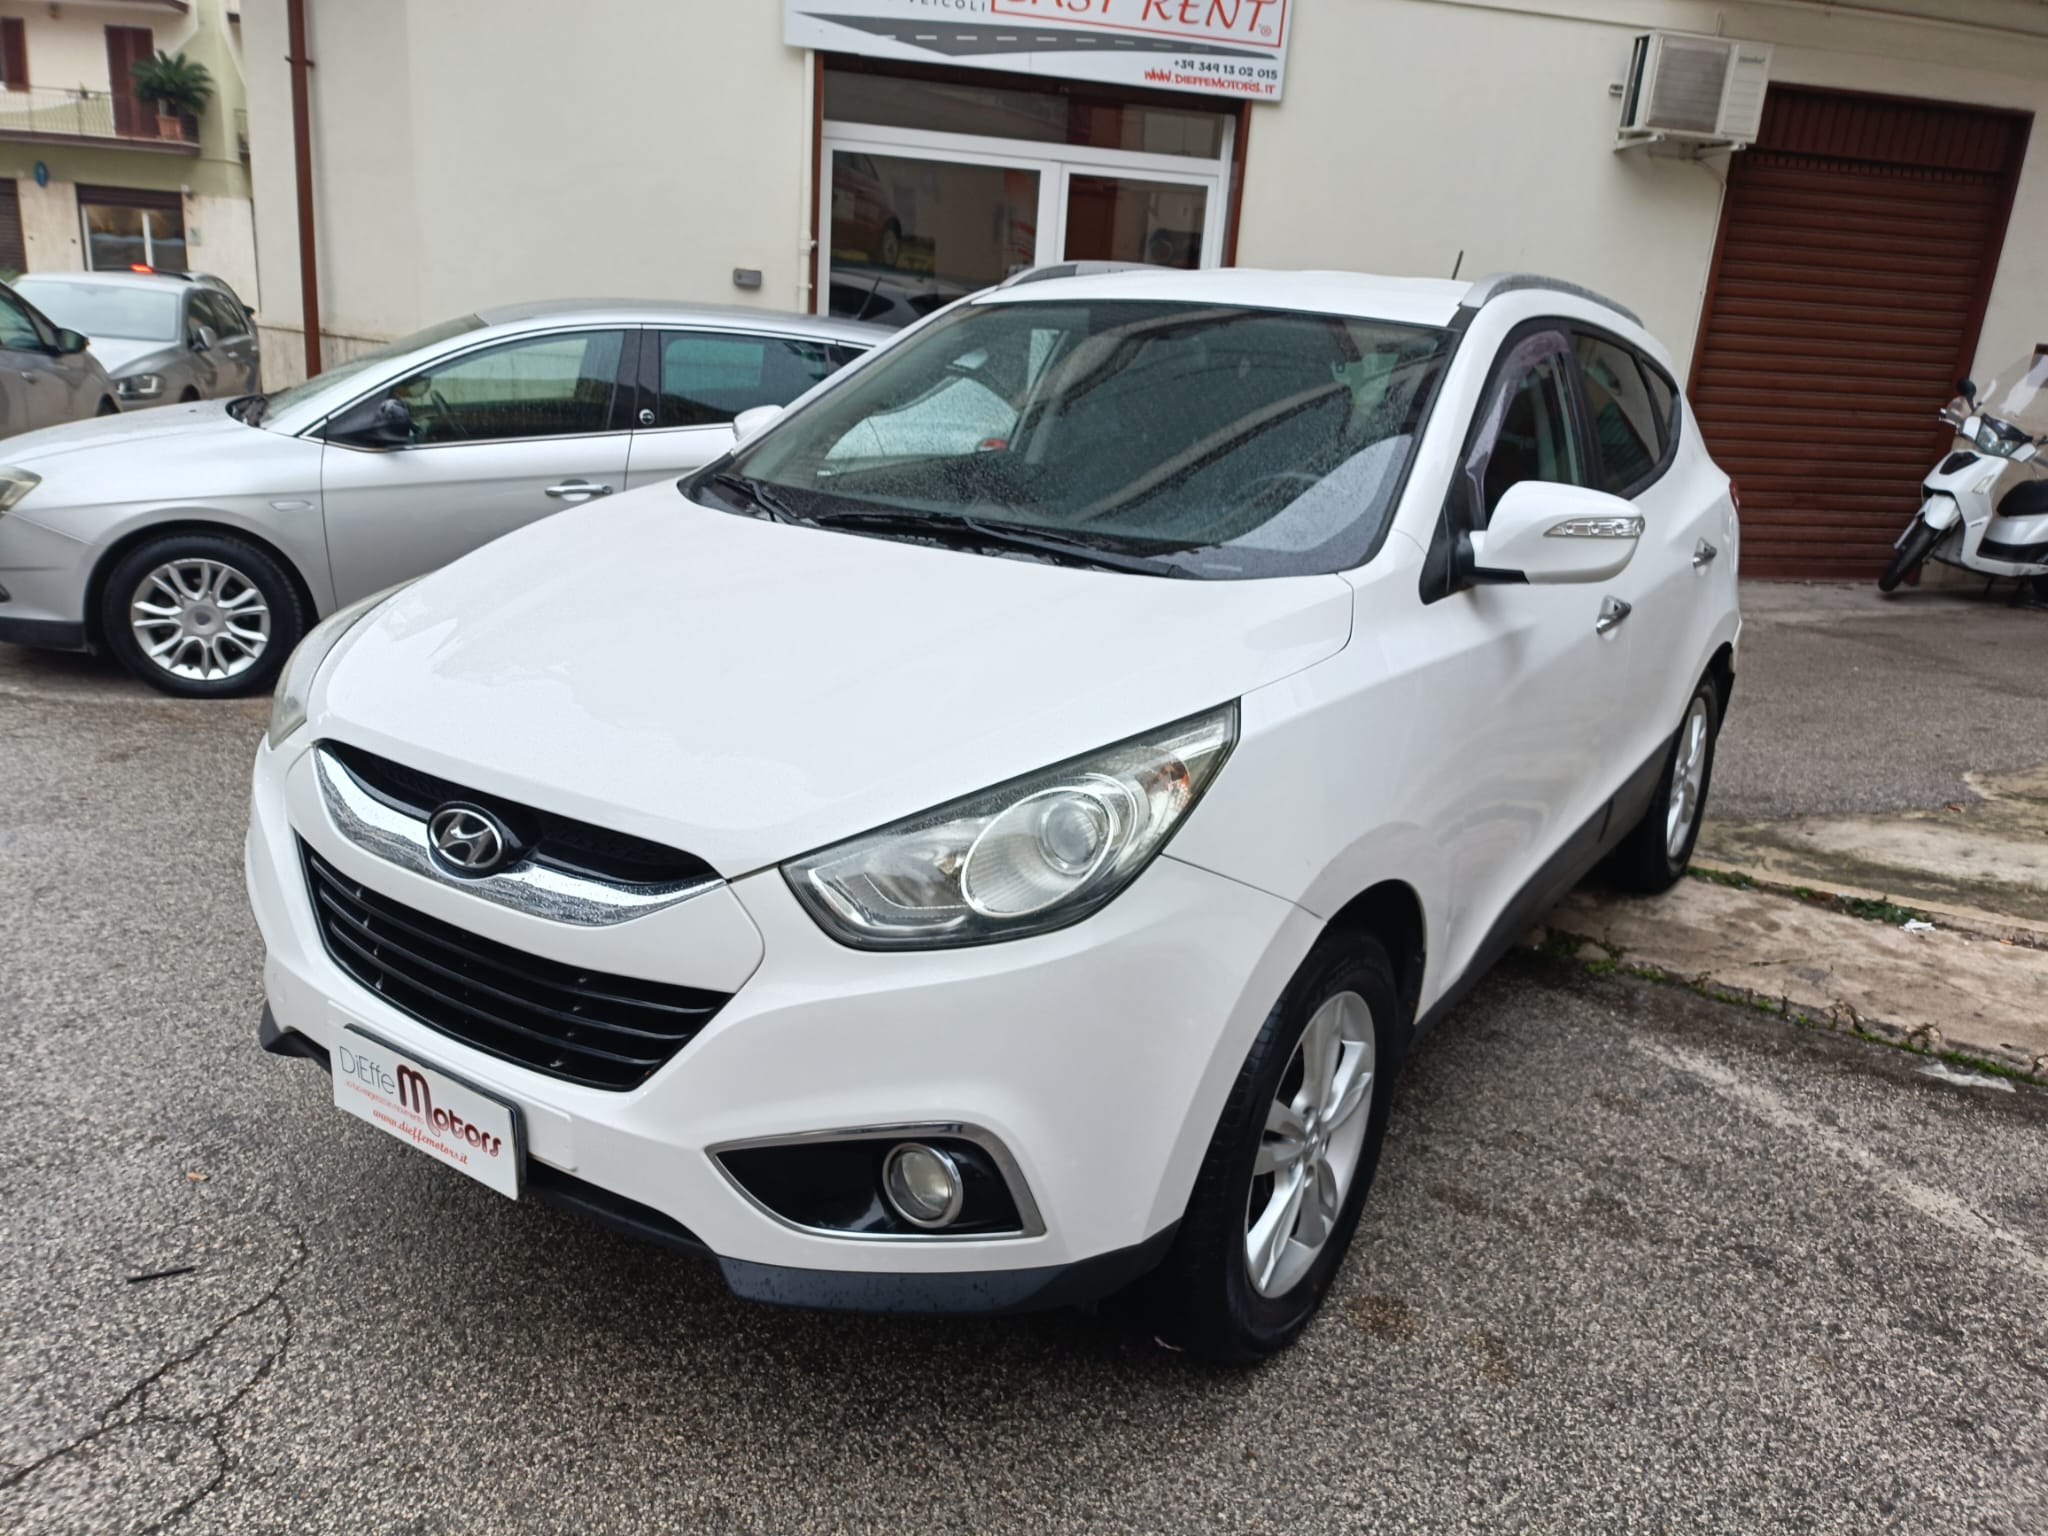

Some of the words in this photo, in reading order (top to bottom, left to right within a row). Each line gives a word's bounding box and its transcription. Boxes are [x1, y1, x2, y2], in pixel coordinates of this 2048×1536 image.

[1174, 59, 1195, 71] +39
[1198, 61, 1220, 73] 349
[1223, 64, 1235, 75] 13
[1238, 66, 1254, 77] 02
[1257, 69, 1278, 80] 015
[339, 1046, 396, 1095] DiEffe
[396, 1064, 502, 1158] Motors
